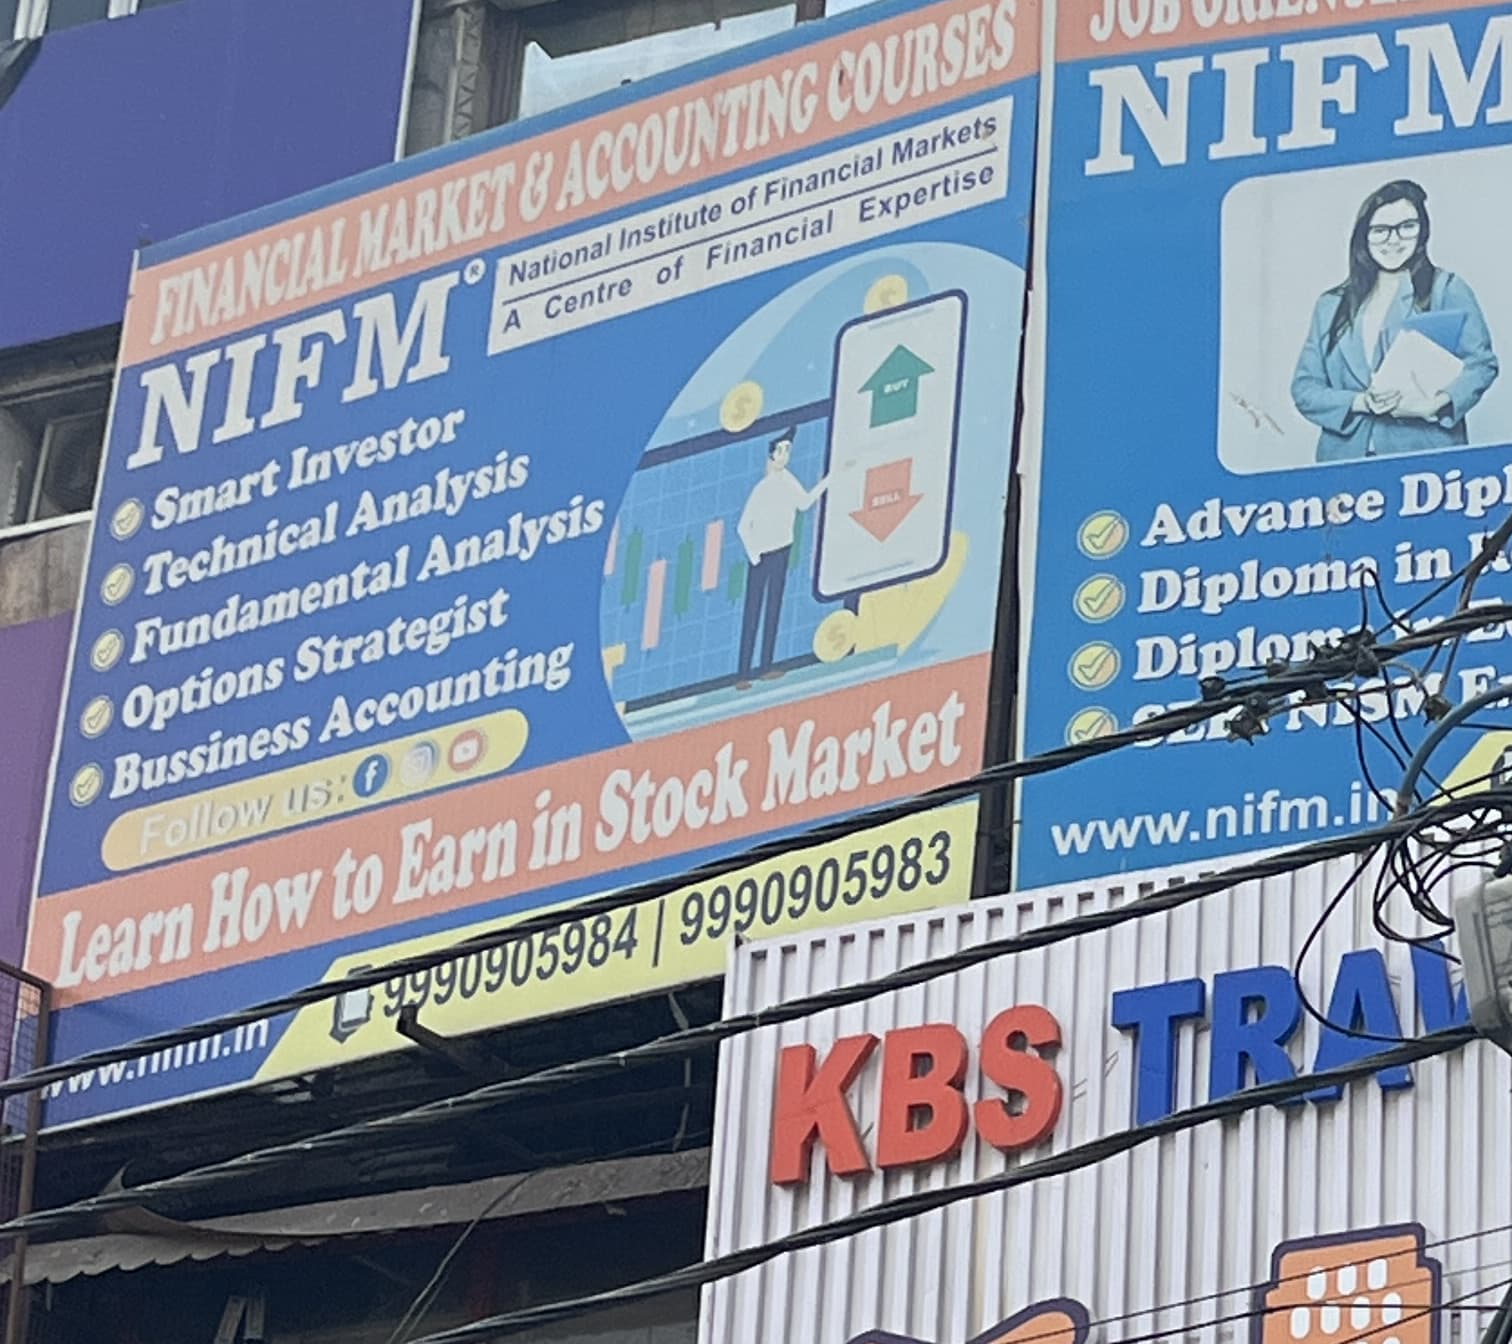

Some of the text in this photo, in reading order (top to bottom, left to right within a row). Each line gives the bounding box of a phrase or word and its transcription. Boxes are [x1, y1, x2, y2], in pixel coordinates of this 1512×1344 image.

[150, 231, 351, 347] FINANCIAL
[357, 159, 515, 274] MARKET
[518, 150, 553, 222] &
[555, 48, 820, 215] ACCOUNTING
[502, 163, 995, 336] A Centre of Financial Expertise
[507, 113, 998, 287] National Institute of Financial Markets
[142, 450, 531, 597] Technical Analysis
[150, 408, 466, 531] Smart Investor
[1139, 489, 1385, 549] Advance
[129, 496, 605, 664] Fundamental Analysis
[1133, 626, 1344, 680] Diplom
[1135, 552, 1381, 619] Diploma
[1395, 540, 1455, 583] in
[109, 642, 576, 801] Bussiness Accounting
[121, 588, 510, 731] Options Strategist
[55, 690, 965, 990] Learn How to Earn in Stock Market
[139, 793, 275, 857] Follow
[1049, 779, 1403, 857] www.nifm.in
[382, 829, 952, 1020] 9990905984 9990905983
[770, 1003, 1063, 1189] KBS
